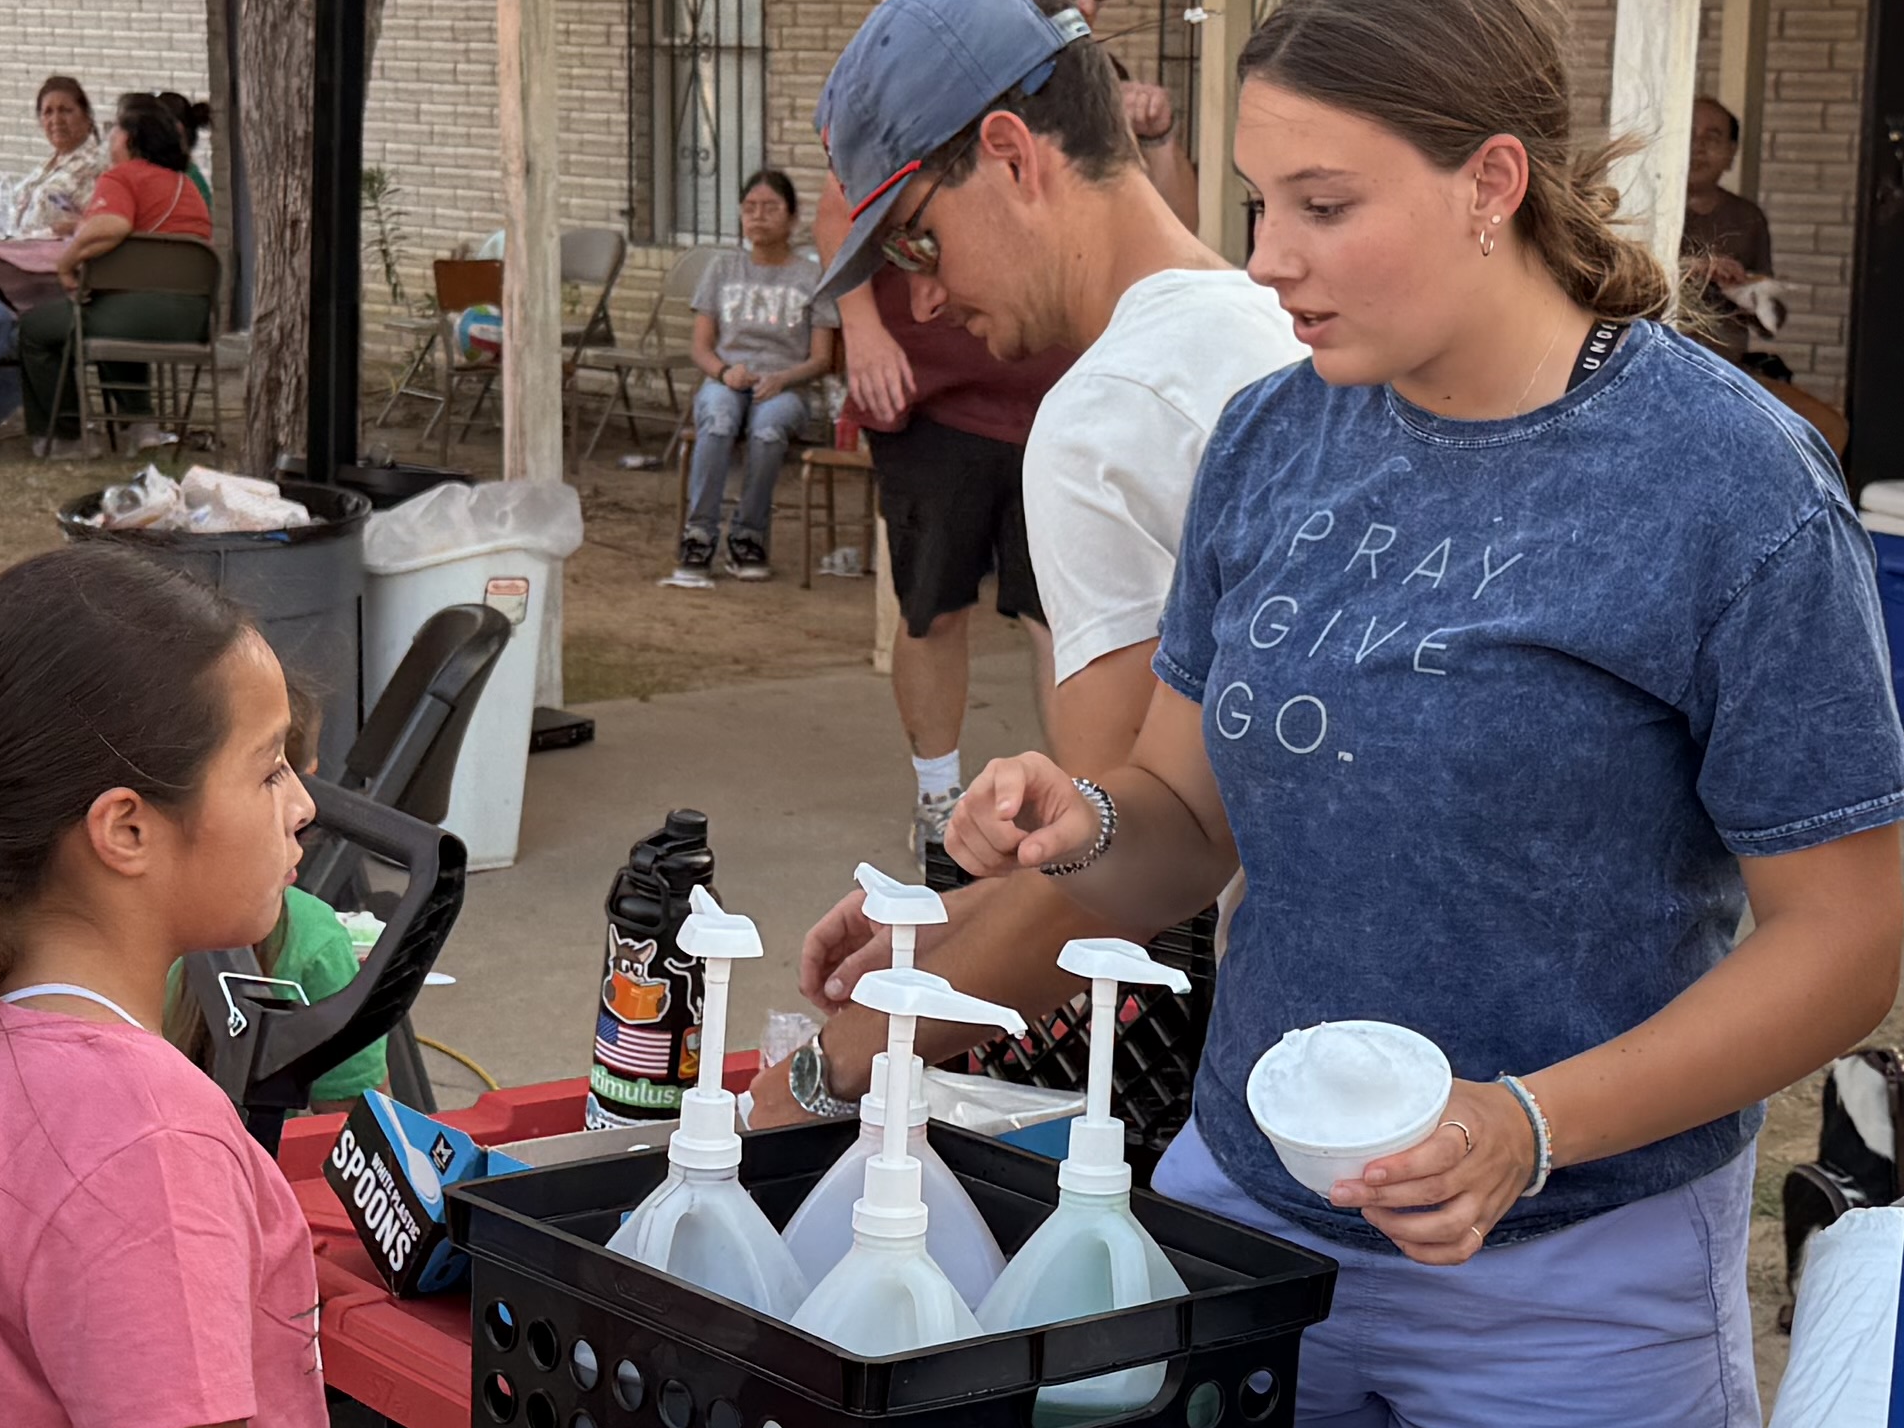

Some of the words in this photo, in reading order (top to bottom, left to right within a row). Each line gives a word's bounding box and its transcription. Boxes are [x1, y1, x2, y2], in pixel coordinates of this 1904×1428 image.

[1287, 510, 1524, 600] PRAY
[1249, 595, 1448, 675] GIVE
[1215, 681, 1355, 762] GO.
[332, 1129, 412, 1272] SPOONS
[371, 1152, 395, 1195] WHITE
[390, 1188, 421, 1242] PLASTIC
